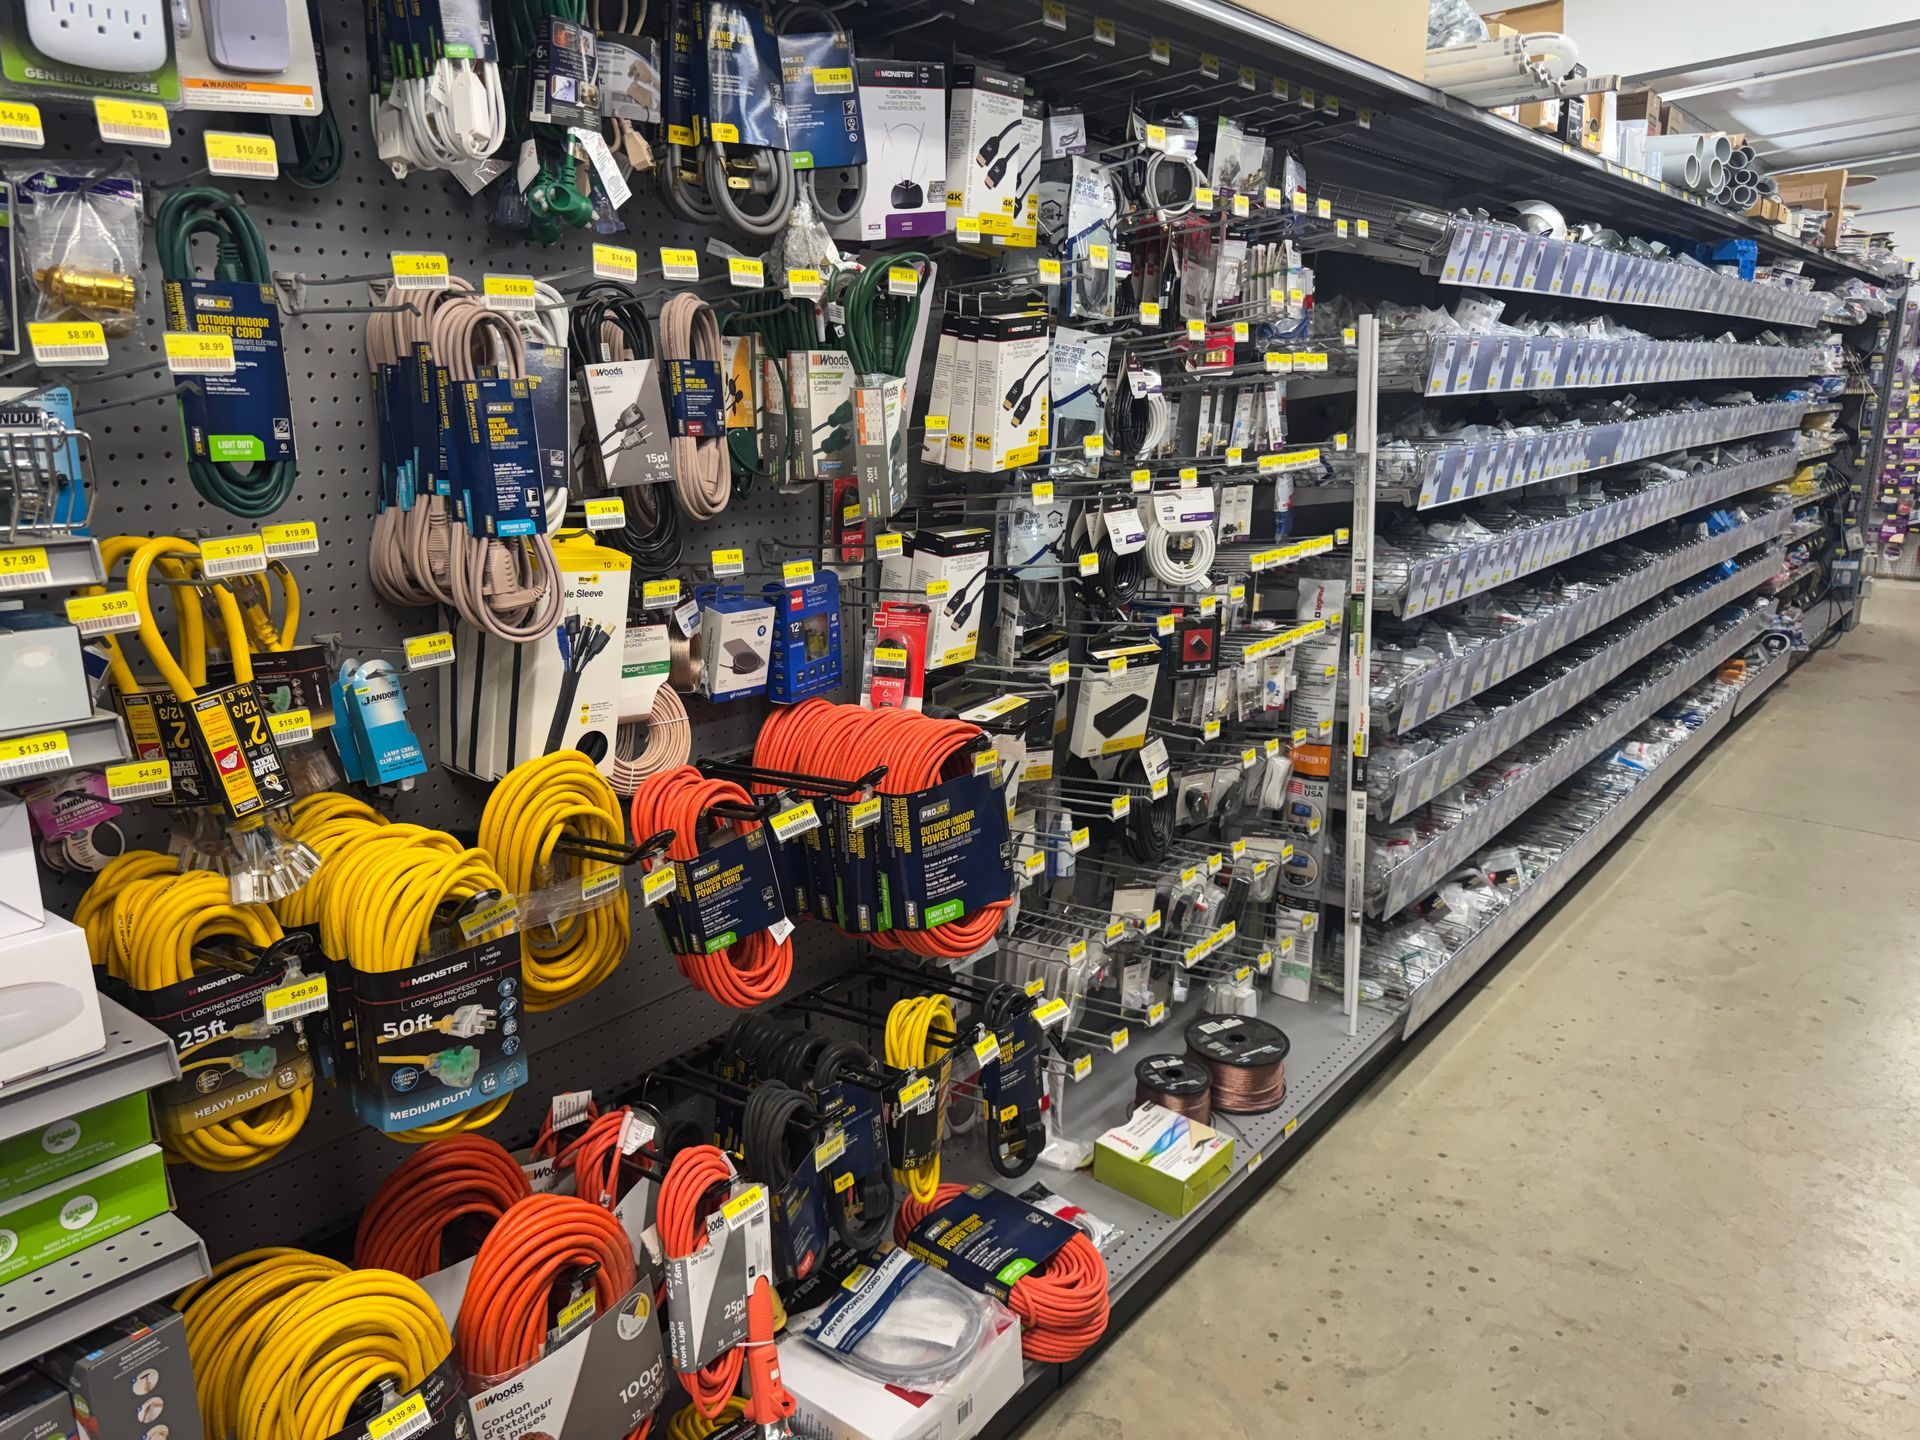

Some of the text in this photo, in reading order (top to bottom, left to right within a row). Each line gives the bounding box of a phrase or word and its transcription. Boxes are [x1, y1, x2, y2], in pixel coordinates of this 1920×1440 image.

[25, 68, 158, 93] GENERAL PURPOSE
[208, 80, 247, 90] WARNING
[986, 76, 1010, 86] MONSTER
[1, 110, 30, 122] $4.99
[131, 109, 158, 120] $3.99
[236, 145, 268, 155] $10.99
[947, 192, 962, 201] 4K
[1003, 199, 1013, 208] 4K
[1027, 212, 1036, 220] 4K
[611, 253, 632, 263] $14.99
[415, 261, 441, 270] $14.99
[504, 284, 528, 293] $18.99
[197, 299, 231, 308] PROJEX
[196, 314, 270, 328] OUTDOOR/INDOOR
[68, 330, 95, 340] $8.99
[198, 325, 262, 339] POWER CORD
[199, 342, 224, 351] $8.99
[820, 355, 849, 365] Woods
[596, 367, 623, 376] Woods
[218, 440, 254, 449] LIGHT DUTY
[951, 436, 964, 444] 4K
[976, 436, 989, 444] 4K
[646, 452, 668, 465] 15pi
[285, 528, 310, 538] $19.99
[225, 544, 253, 555] $17.99
[3, 556, 36, 566] $7.99
[576, 590, 603, 598] Sleeve
[807, 584, 828, 595] HDMI
[790, 597, 803, 605] RCA
[1315, 586, 1325, 610] legrand
[102, 600, 128, 611] $6.99
[428, 638, 447, 648] $8.99
[875, 679, 901, 688] HDMI
[361, 690, 401, 706] JANDORF
[160, 708, 184, 719] 12/3
[233, 701, 258, 718] 12/3
[279, 717, 304, 727] $15.99
[171, 722, 190, 748] 2
[246, 716, 267, 744] 2
[18, 741, 57, 755] $13.99
[383, 746, 414, 758] LAMP CORD
[172, 760, 196, 769] JACKET
[252, 754, 275, 767] JACKET
[379, 751, 420, 765] CLIP-IN SOCKET
[1299, 754, 1328, 765] SCREEN TV
[139, 768, 162, 777] $4.99
[173, 767, 199, 776] YELLOW
[254, 763, 280, 777] YELLOW
[1304, 789, 1322, 799] USA
[56, 802, 103, 824] DESK GROMMET
[788, 809, 809, 821] $22.99
[922, 803, 948, 819] PROJEX
[892, 798, 903, 848] POWER CORD
[900, 798, 912, 854] OUTDOOR/INDOOR
[920, 810, 975, 836] OUTDOOR/INDOOR
[921, 821, 971, 847] POWER CORD
[848, 831, 857, 853] CORD
[694, 864, 718, 878] PROJEX
[694, 864, 745, 891] OUTDOOR/INDOOR
[696, 883, 721, 899] POWER
[722, 873, 741, 888] CORD
[928, 904, 957, 919] LIGHT DUTY
[480, 951, 501, 963] POWER
[411, 962, 468, 985] MONSTER
[291, 985, 319, 999] $49.99
[411, 975, 495, 1008] LOCKING PROFESSIONAL
[433, 988, 478, 1008] GRADE CORD
[192, 983, 277, 1018] LOCKING PROFESSIONAL
[216, 995, 262, 1017] GRADE CORD
[383, 1013, 434, 1039] 50ft
[178, 1019, 228, 1049] 25ft
[1000, 1032, 1015, 1043] PROJEX
[281, 1072, 293, 1082] 12
[394, 1071, 416, 1081] LIGHTED
[394, 1075, 417, 1085] LOCKING
[483, 1079, 496, 1089] 14
[194, 1084, 269, 1119] HEAVY DUTY
[390, 1088, 473, 1121] MEDIUM DUTY
[825, 1098, 843, 1111] PROJEX
[739, 1193, 757, 1208] $29.99
[928, 1219, 949, 1237] PROJEX
[937, 1213, 981, 1246] OUTDOOR/INDOOR
[944, 1220, 983, 1250] POWER CORD
[690, 1252, 715, 1266] de Travail
[831, 1248, 858, 1269] POWER
[907, 1241, 949, 1268] OUTDOOR/INDOOR
[675, 1262, 683, 1285] 7.6m
[824, 1312, 845, 1337] DRYER
[844, 1293, 866, 1314] POWER
[864, 1275, 881, 1294] CORD
[881, 1249, 903, 1271] 3-WIRE
[984, 1285, 1006, 1298] PROJEX
[724, 1294, 746, 1320] 25pi
[670, 1321, 678, 1357] Woods
[619, 1354, 663, 1404] 100pi
[485, 1381, 524, 1407] Woods
[387, 1404, 417, 1426] $139.99
[482, 1402, 531, 1430] Cordon
[484, 1398, 552, 1440] d'extérieur
[632, 1409, 642, 1421] 12
[34, 1420, 52, 1433] Easy
[35, 1422, 58, 1440] Install
[509, 1413, 546, 1440] prises
